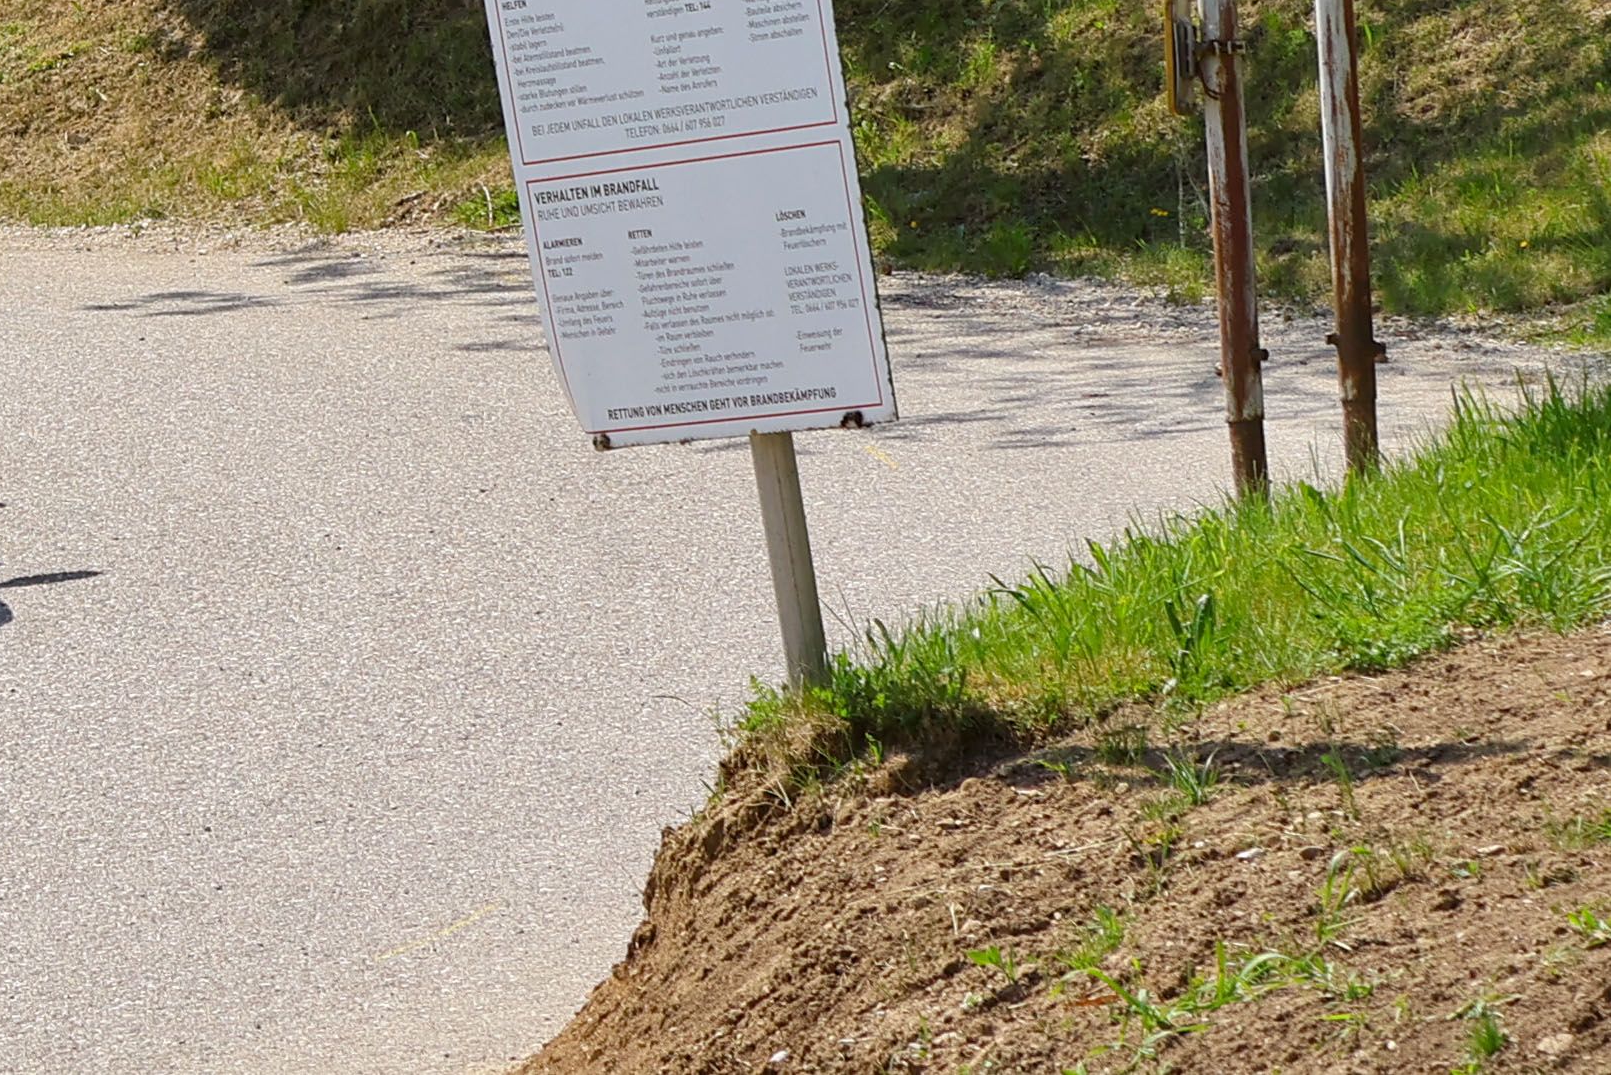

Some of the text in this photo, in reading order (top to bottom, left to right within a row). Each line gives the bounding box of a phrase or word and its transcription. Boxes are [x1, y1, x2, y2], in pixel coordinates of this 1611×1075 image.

[501, 0, 527, 11] HELFEN
[531, 124, 545, 137] BEI
[546, 121, 571, 135] JEDEM
[570, 117, 601, 131] UNFALL
[600, 114, 618, 127] DEN
[617, 109, 654, 125] LOKALEN
[653, 95, 759, 119] WERKSVERANTWORTLICHEN
[758, 86, 818, 105] VERSTÄNDIGEN
[533, 177, 660, 205] VERHALTEN IM BRANDFALL
[536, 195, 664, 221] RUHE UND UMSICHT BEWAHREN
[774, 209, 807, 222] LÖSCHEN
[542, 237, 583, 250] ALARMIEREN
[627, 228, 653, 240] RETTEN
[606, 386, 837, 420] RETTUNG VON MENSCHEN GEHT VOR BRANDBEKÄMPFUNG
